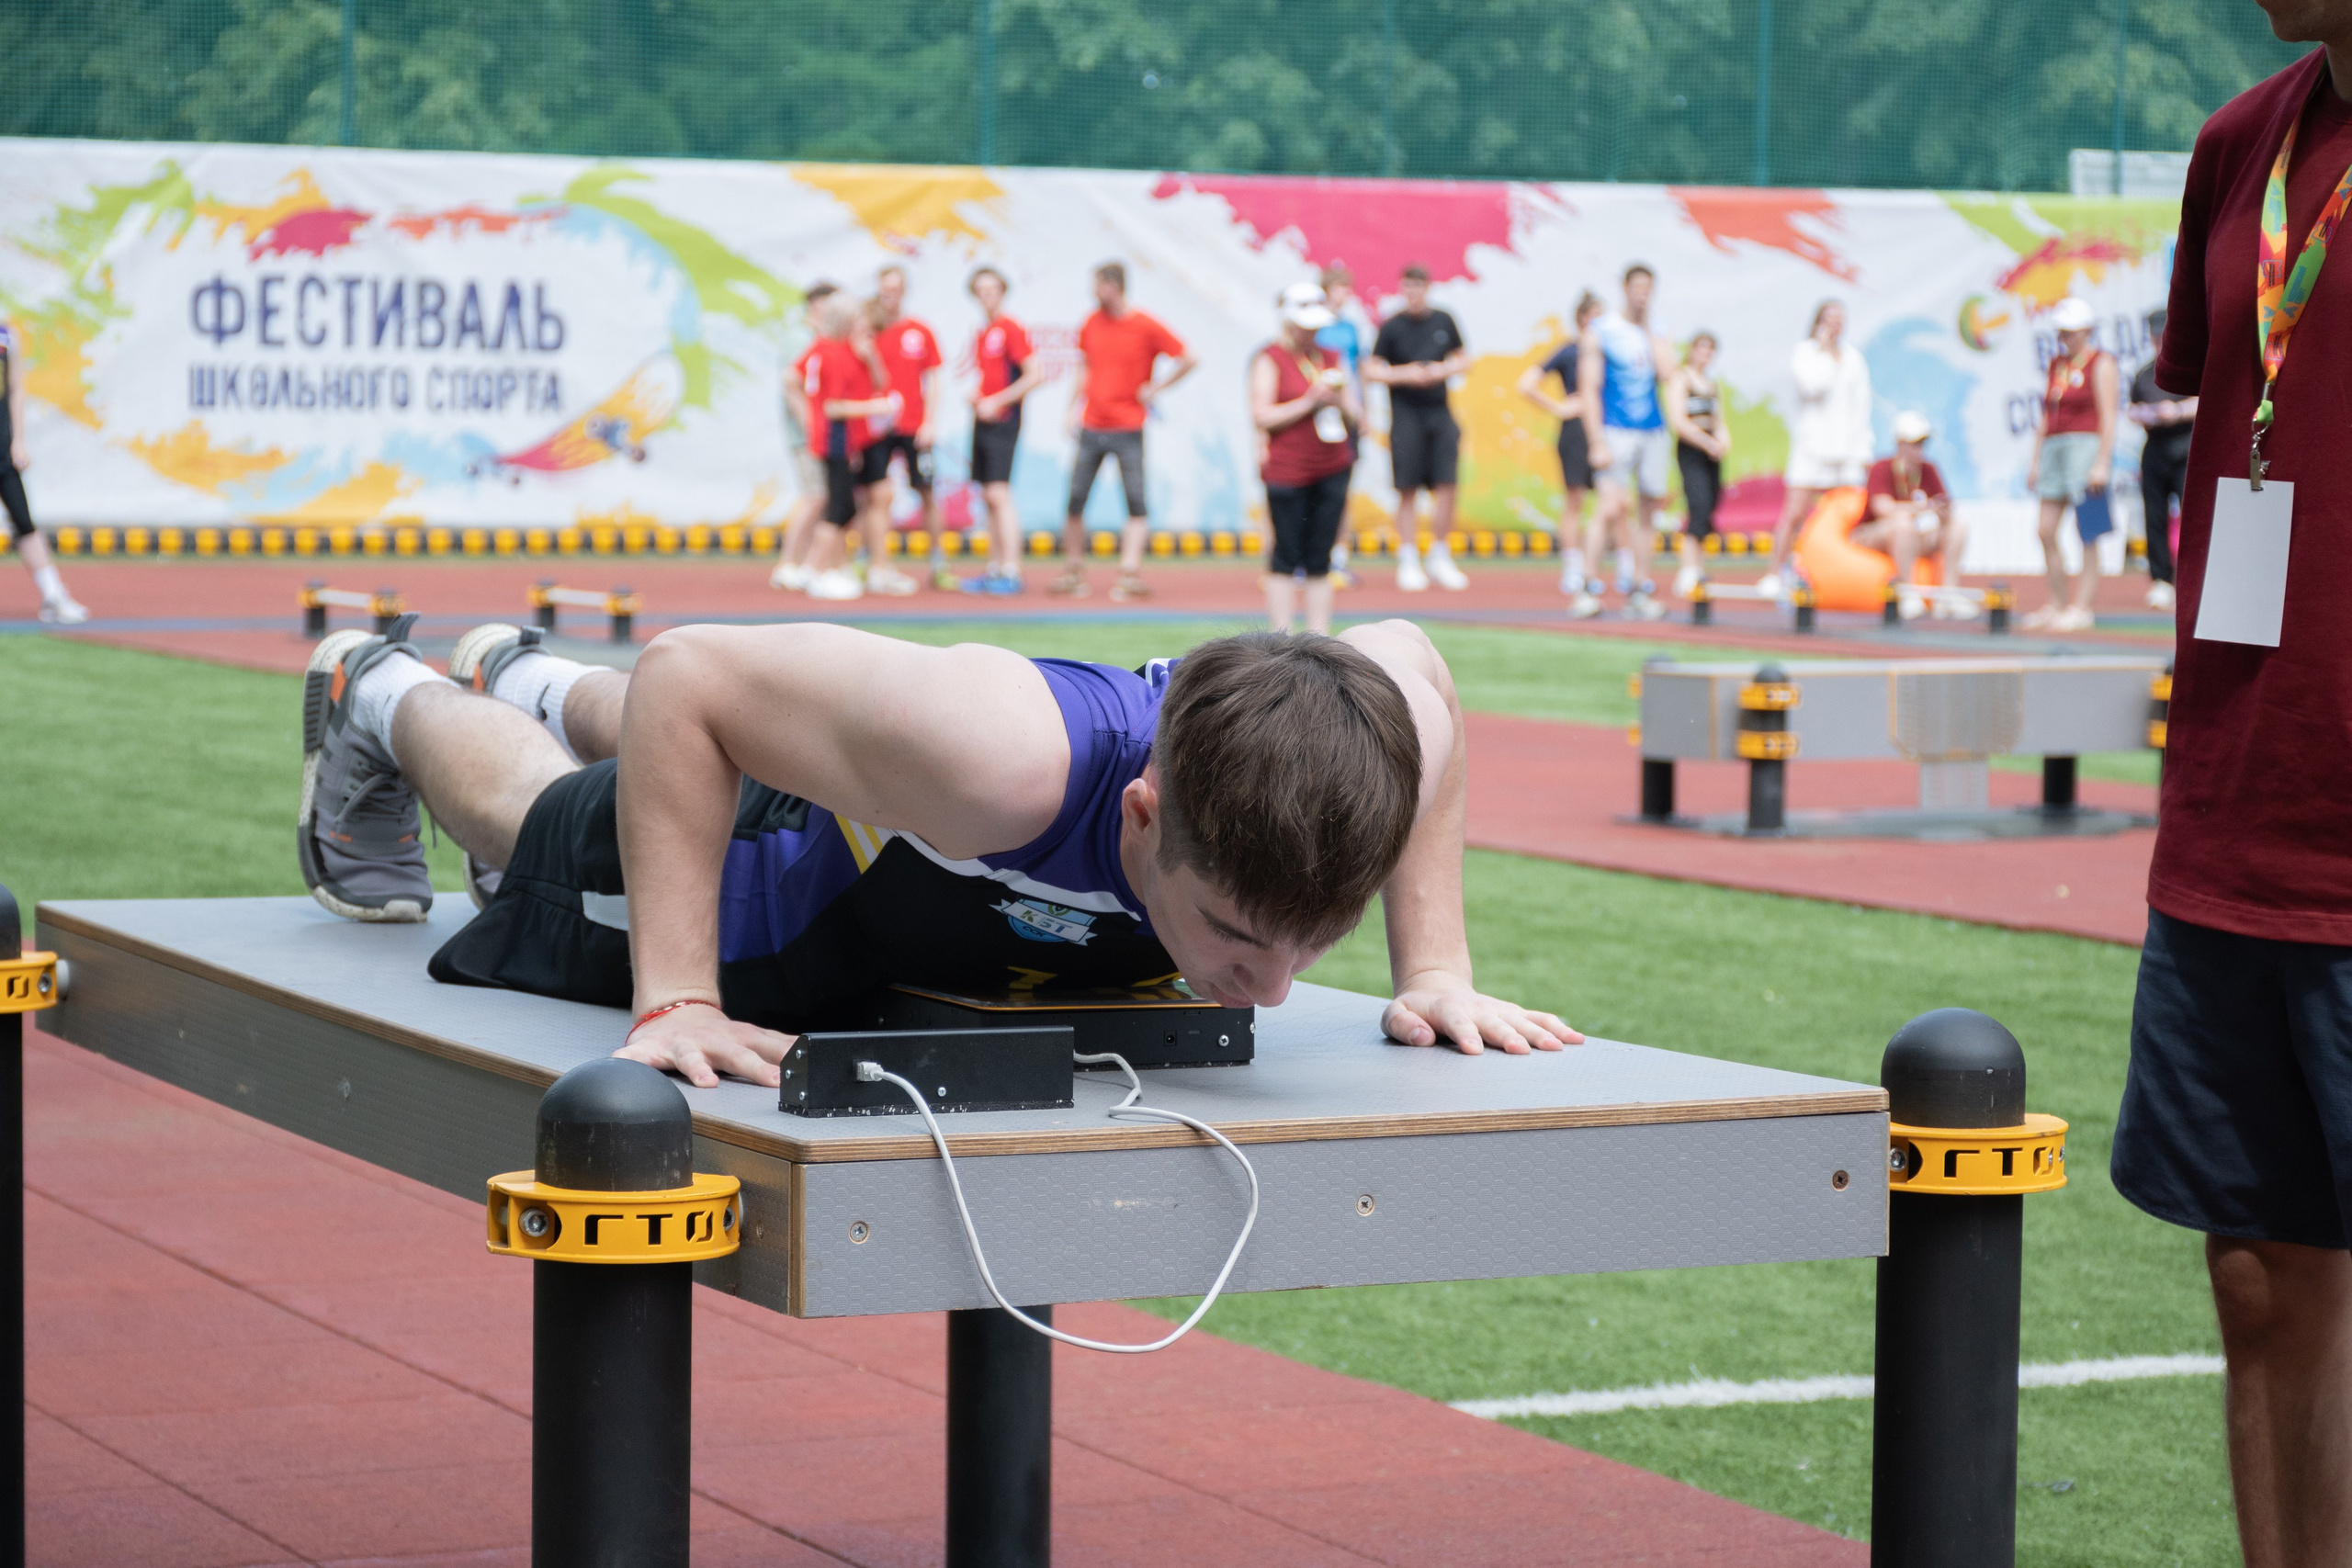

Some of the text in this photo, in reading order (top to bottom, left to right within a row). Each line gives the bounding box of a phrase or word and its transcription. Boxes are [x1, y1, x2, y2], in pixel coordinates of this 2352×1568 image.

[191, 274, 565, 352] ФЕСТИВАЛЬ
[189, 366, 562, 412] ШКОЛЬНОГО СПОРТА
[1943, 1145, 2054, 1179] ГТО
[582, 1210, 714, 1247] ГТО
